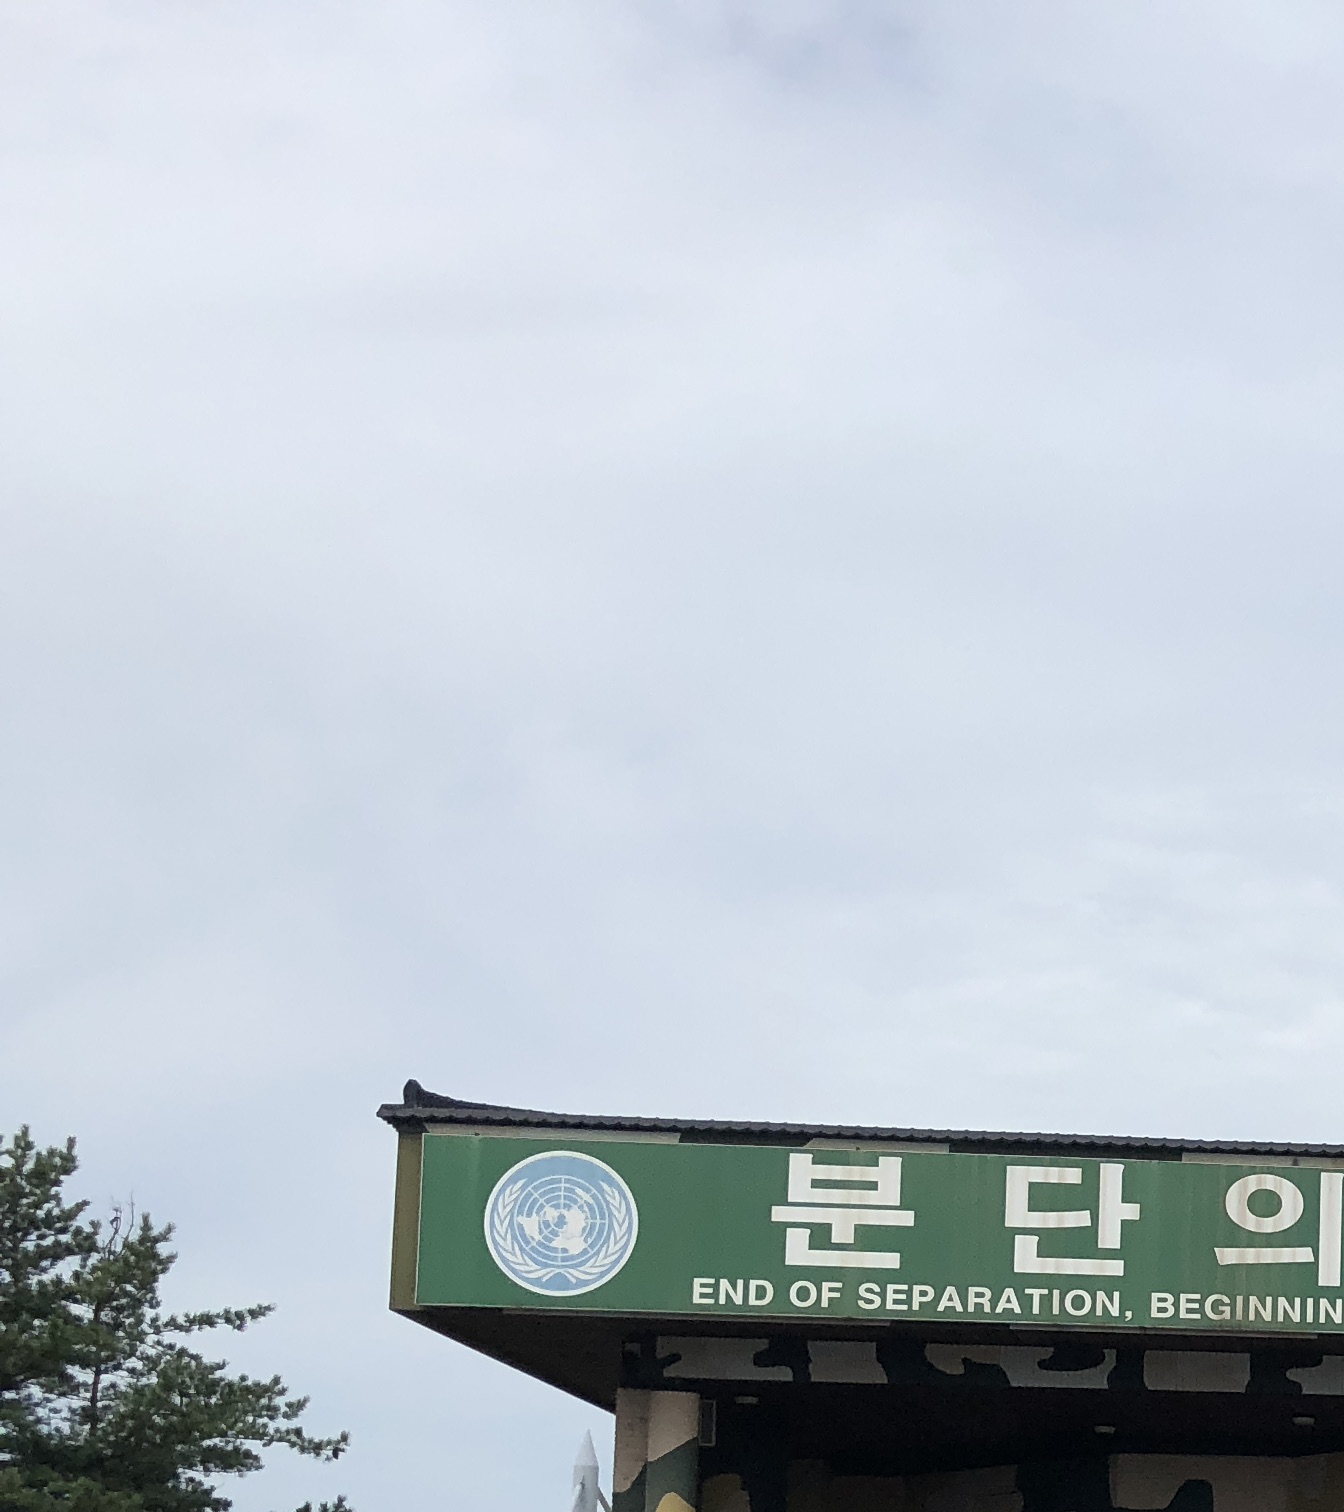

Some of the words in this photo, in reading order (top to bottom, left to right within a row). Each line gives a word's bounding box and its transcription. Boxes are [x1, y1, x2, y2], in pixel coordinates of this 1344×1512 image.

[770, 1152, 1344, 1287] 분단의
[692, 1277, 774, 1306] END
[789, 1280, 843, 1308] OF
[857, 1282, 1133, 1322] SEPARATION,
